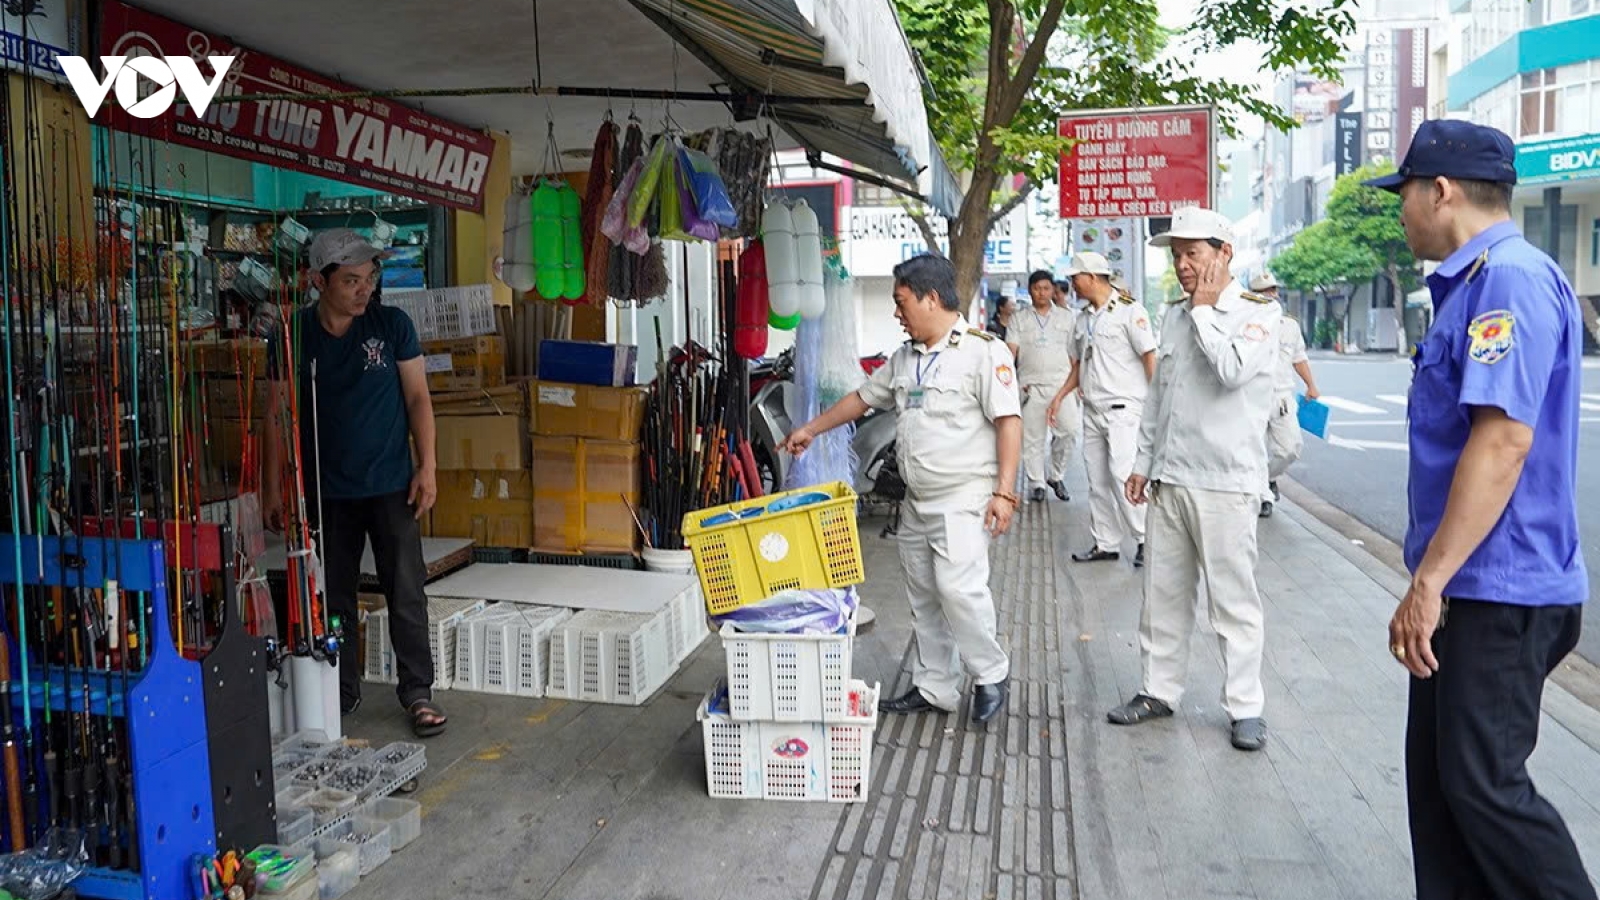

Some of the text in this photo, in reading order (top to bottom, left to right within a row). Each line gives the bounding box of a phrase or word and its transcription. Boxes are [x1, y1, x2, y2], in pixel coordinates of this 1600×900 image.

[332, 105, 489, 194] YANMAR
[1099, 156, 1124, 169] SÁCH
[1550, 149, 1597, 172] BIDV
[1112, 187, 1132, 200] MUA
